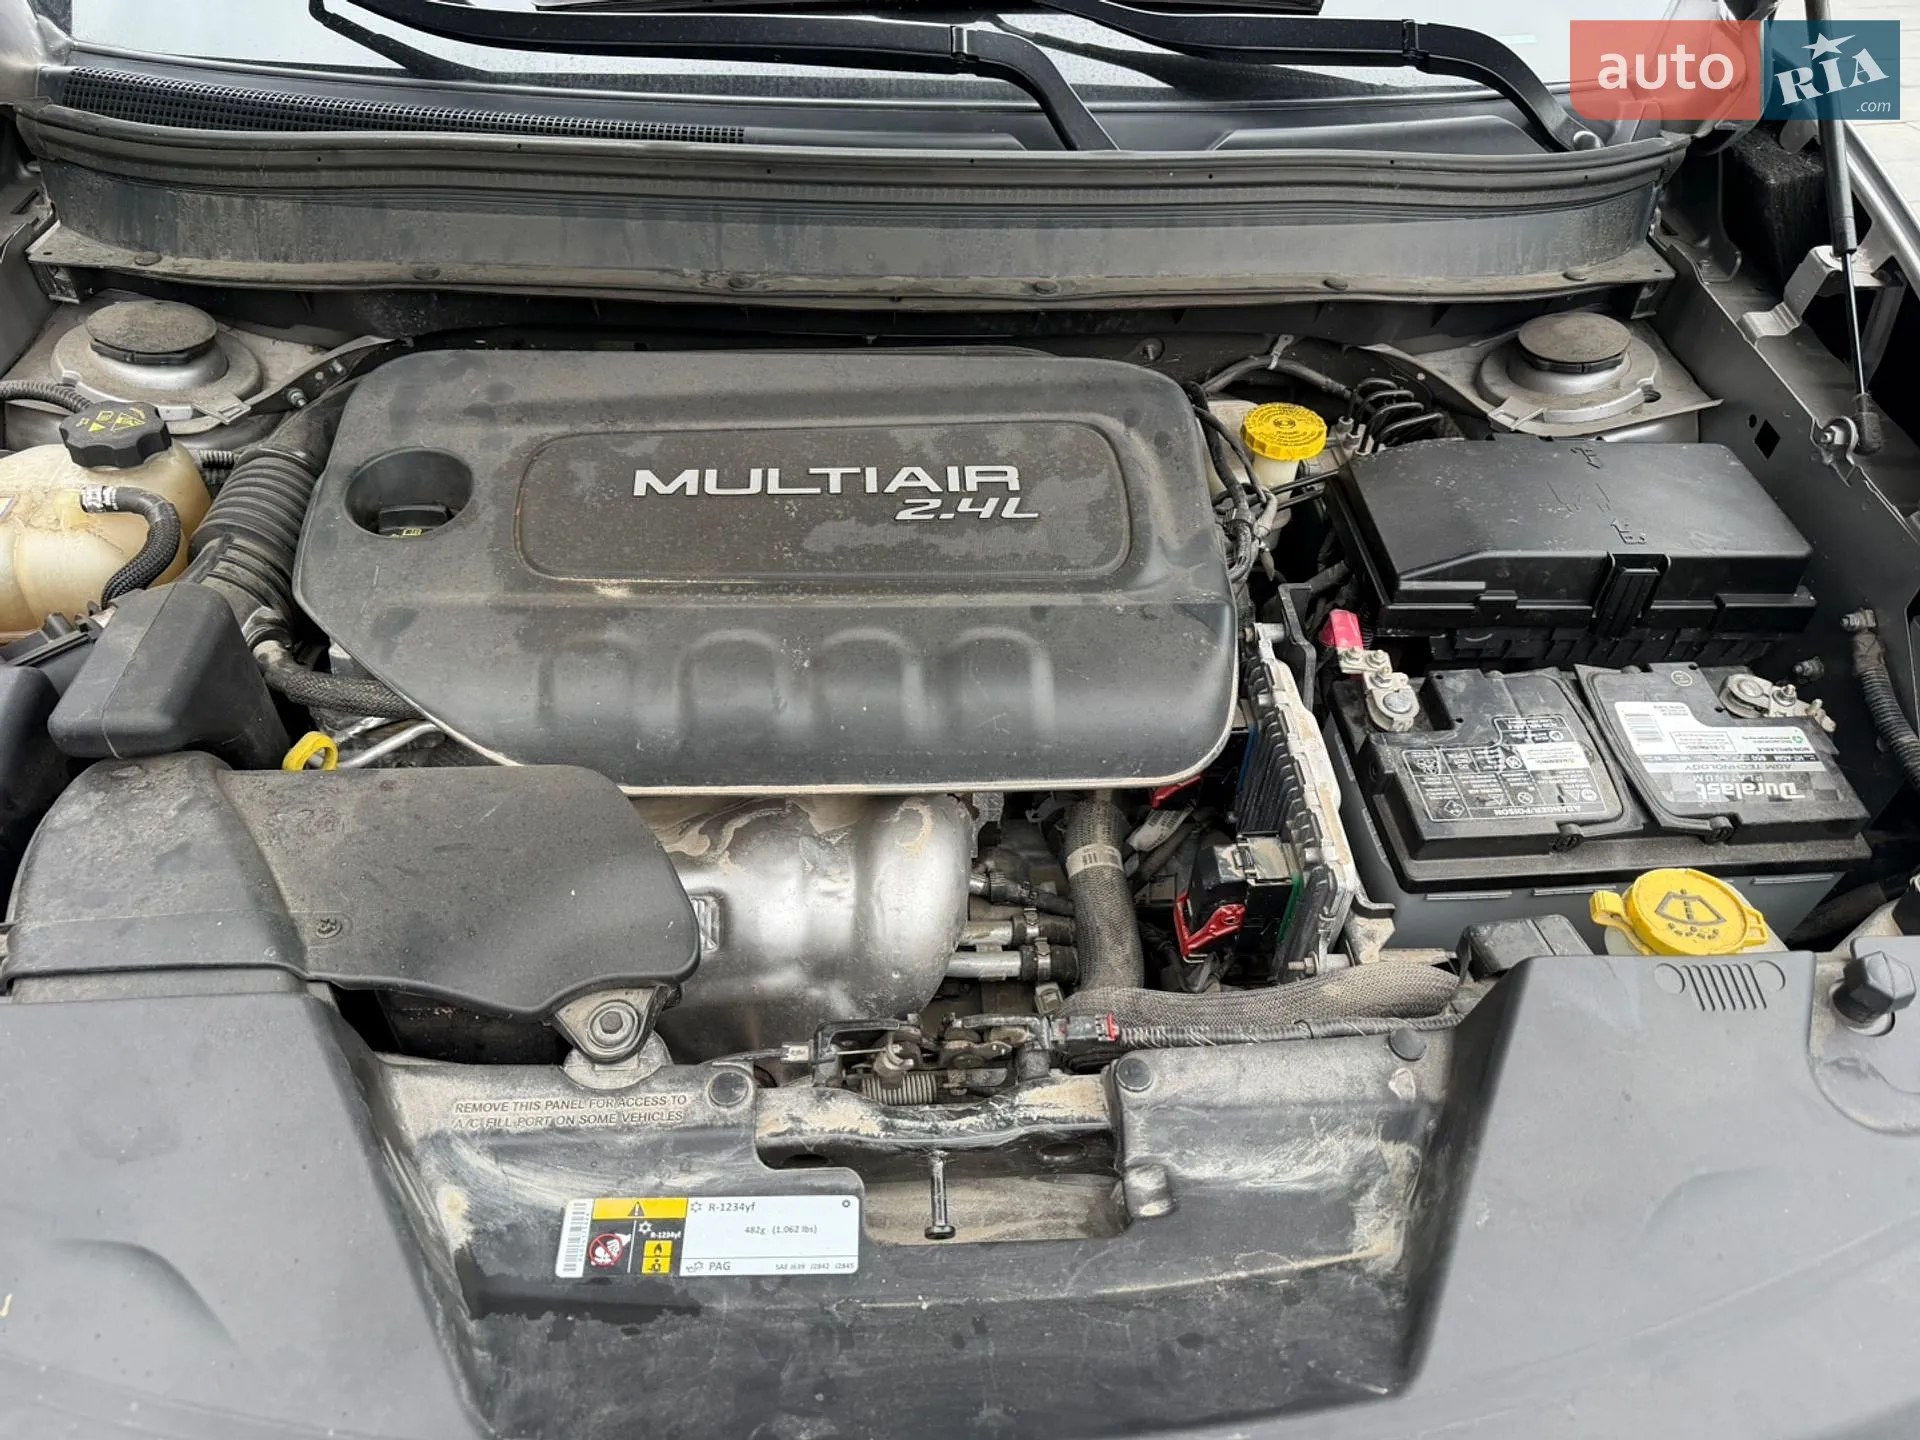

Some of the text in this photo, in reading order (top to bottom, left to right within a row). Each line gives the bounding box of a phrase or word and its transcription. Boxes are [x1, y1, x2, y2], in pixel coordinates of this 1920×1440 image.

[632, 465, 1021, 497] MULTIAIR
[894, 496, 1040, 521] 2.4L
[1691, 772, 1763, 782] PLATINUM
[1695, 781, 1806, 800] Duralast
[454, 1094, 687, 1114] REMOVE THIS PANEL FOR ACCESS TO
[453, 1110, 684, 1129] A/C FILL PORT ON SOME VEHICLES
[708, 1201, 756, 1213] R-1234yf
[650, 1230, 682, 1240] R-1234yf
[744, 1224, 818, 1235] 482g (1.062 lbs)
[708, 1261, 732, 1271] PAG
